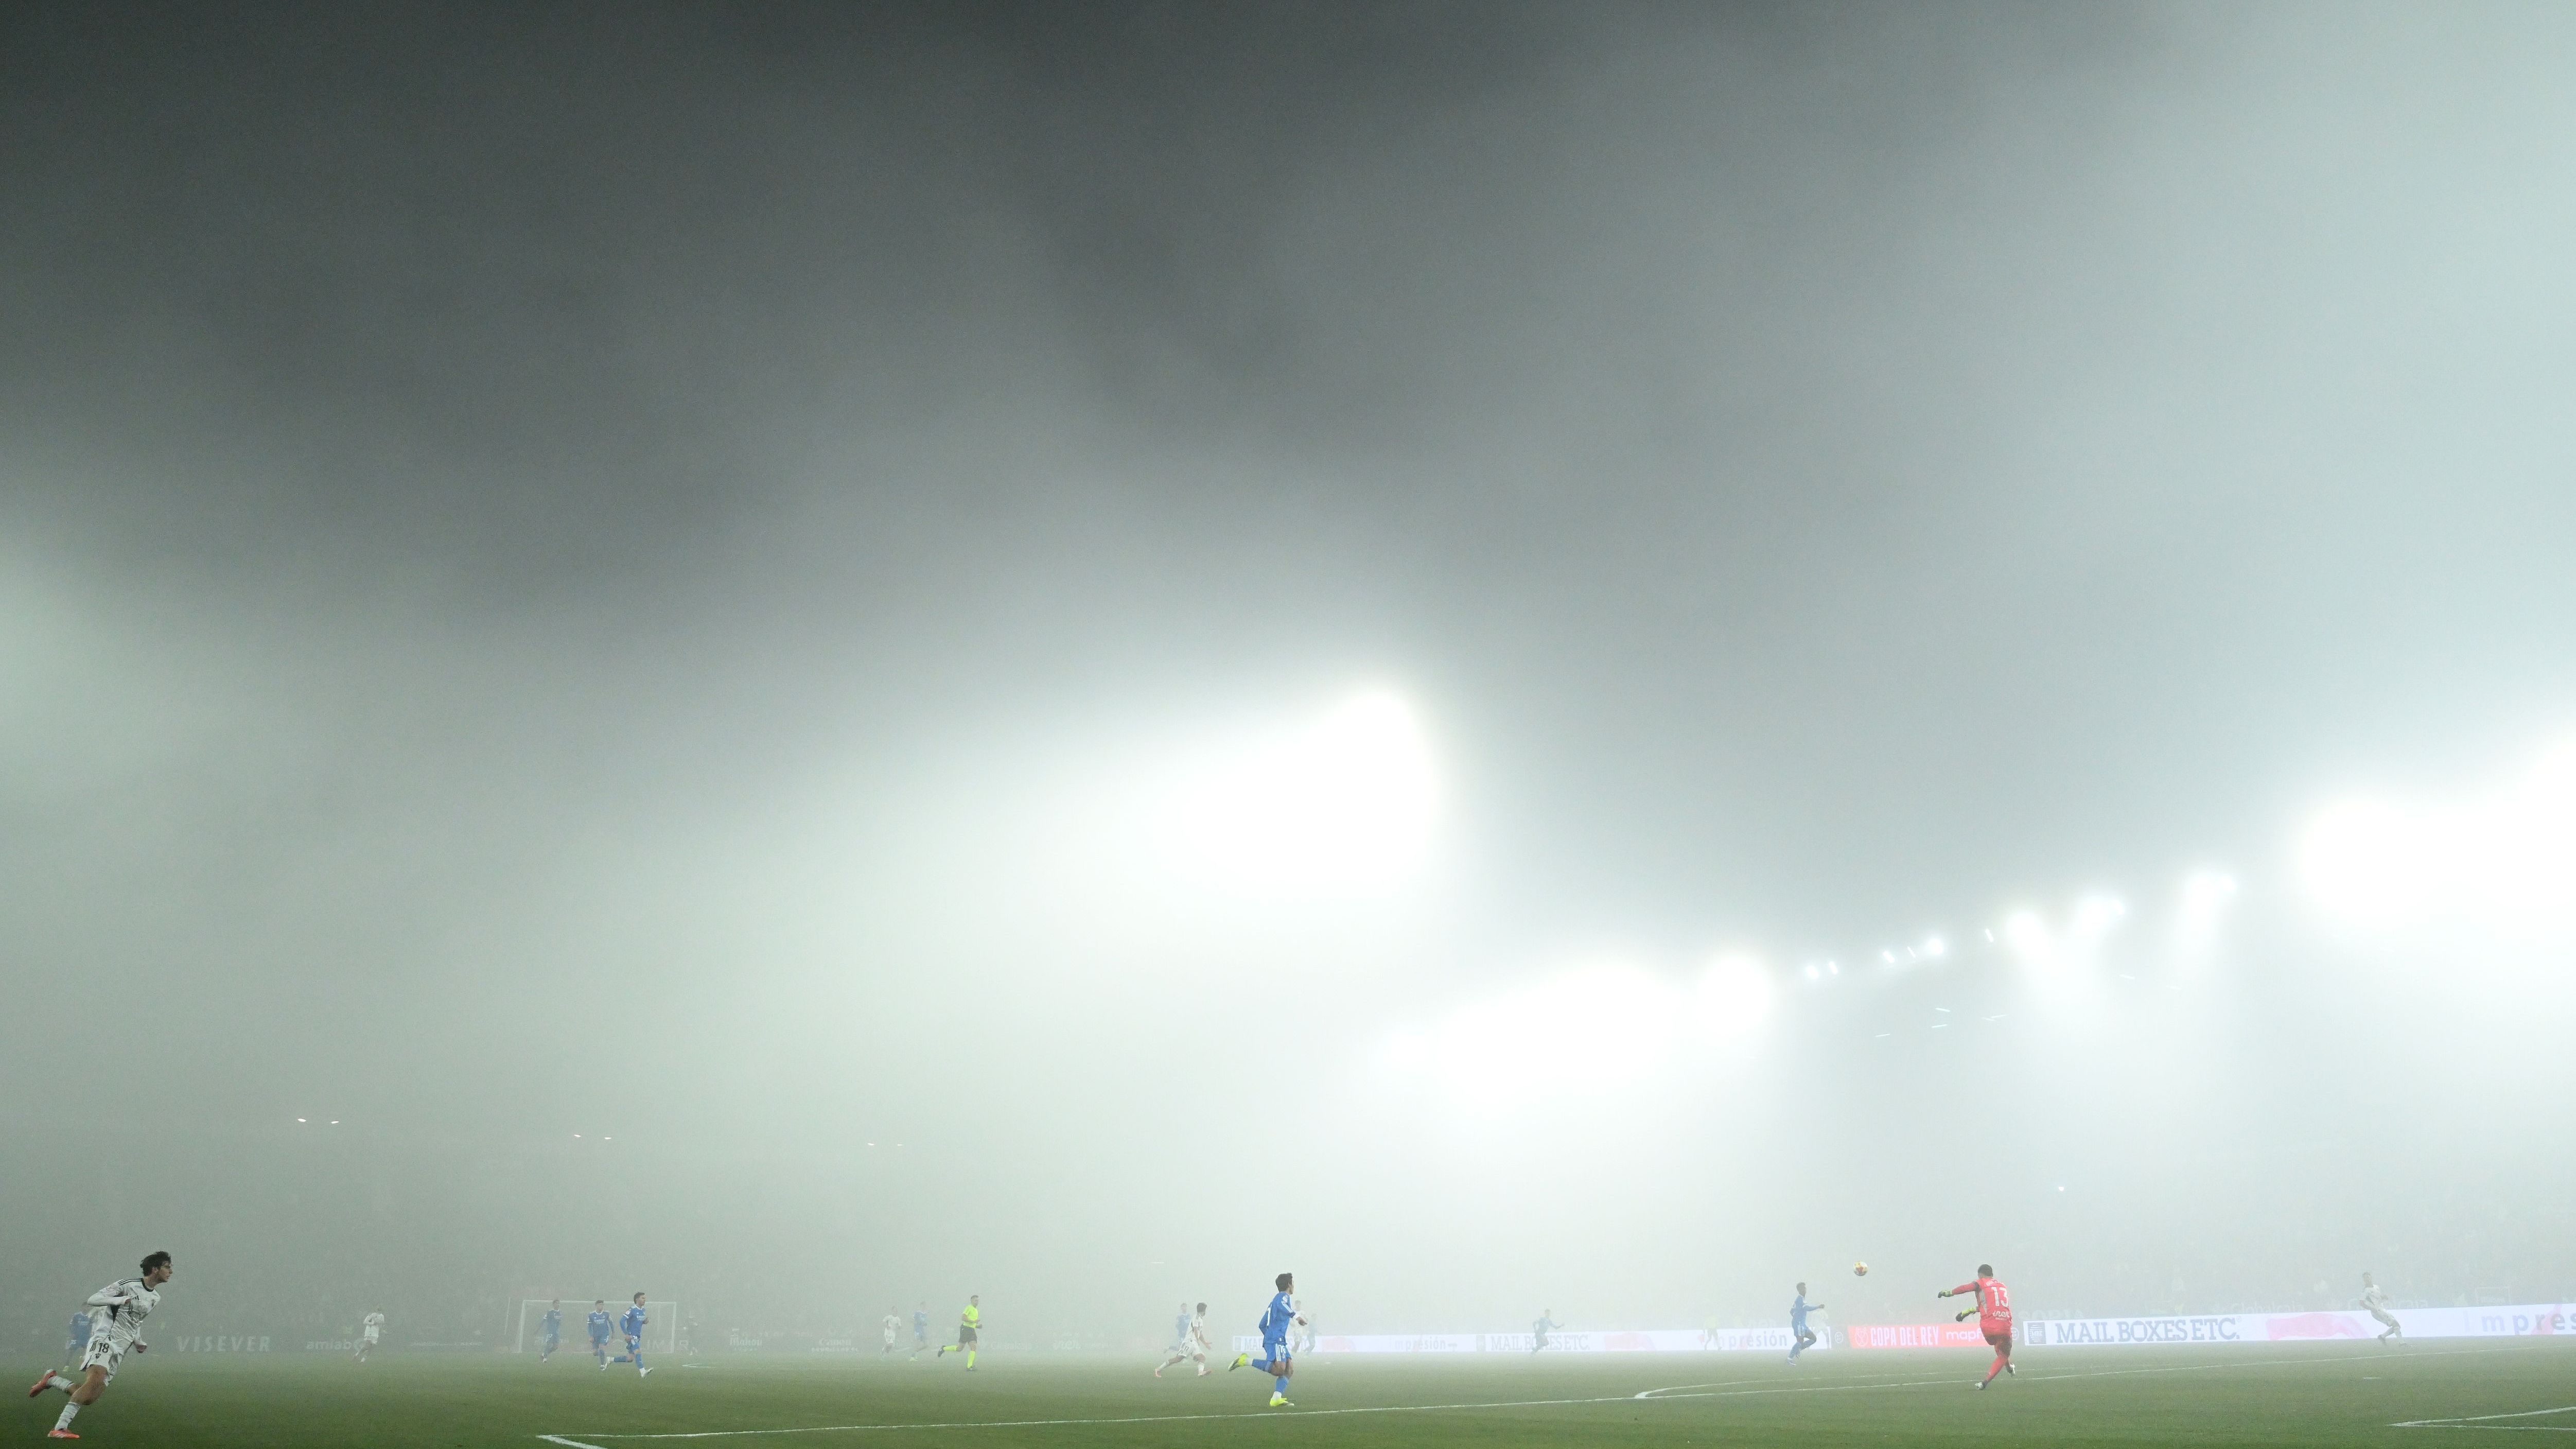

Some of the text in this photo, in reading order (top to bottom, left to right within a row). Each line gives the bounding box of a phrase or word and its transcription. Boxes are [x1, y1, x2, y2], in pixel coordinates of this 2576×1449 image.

[1991, 1286, 2009, 1307] 13
[1871, 1325, 1939, 1347] COPA DEL REY
[1946, 1329, 1982, 1342] mapf
[2055, 1317, 2240, 1343] MAIL BOXES ETC.
[98, 1342, 110, 1353] 18
[177, 1336, 272, 1352] VISEVER
[306, 1338, 352, 1351] amiab
[1491, 1335, 1524, 1351] MAIL
[1525, 1335, 1563, 1351] BOES
